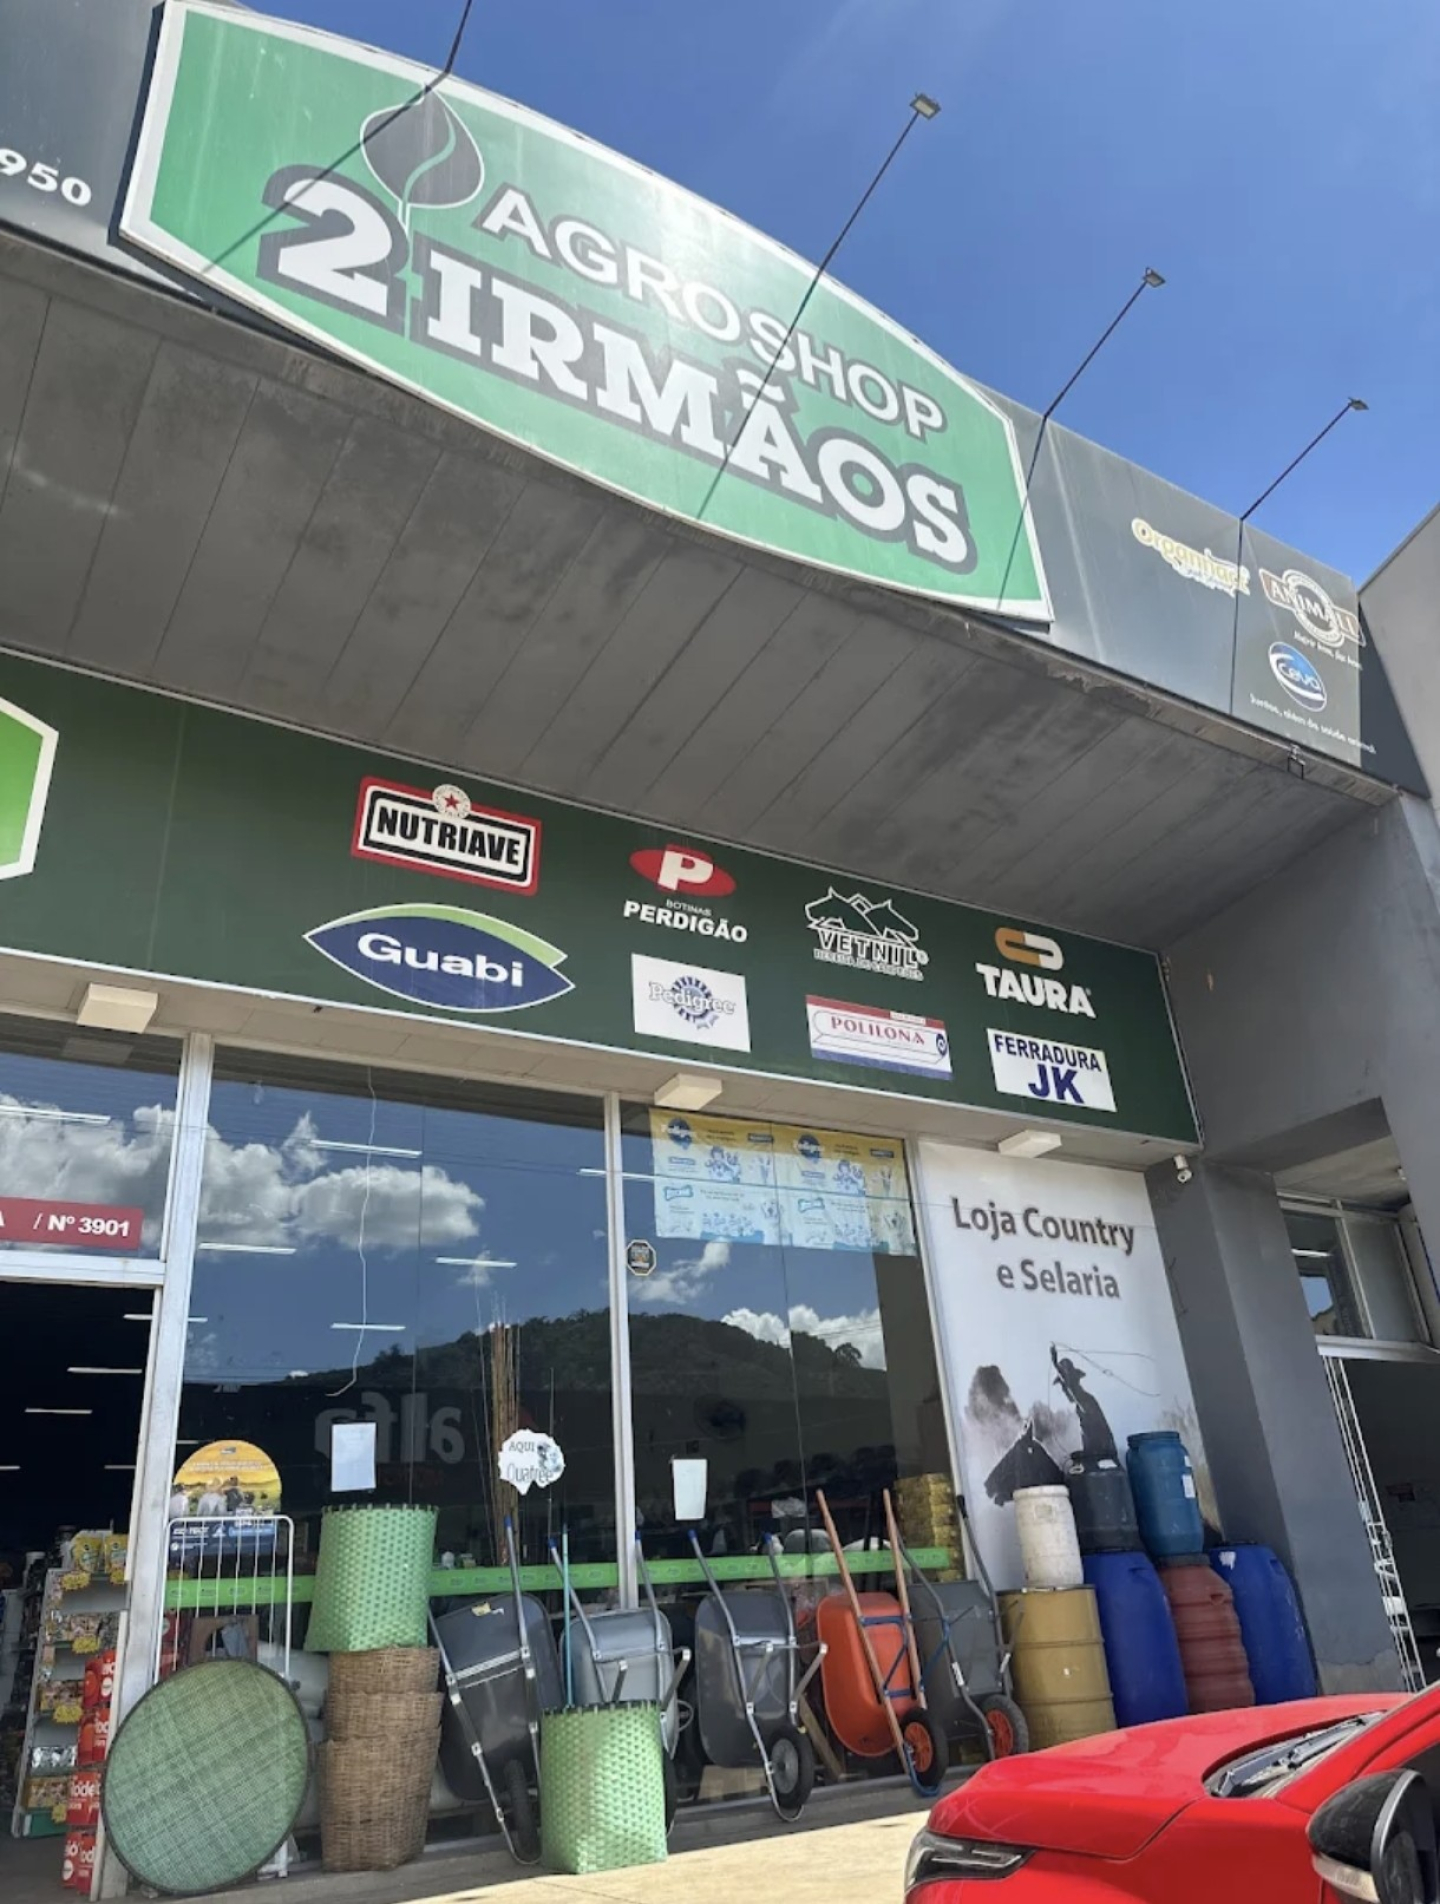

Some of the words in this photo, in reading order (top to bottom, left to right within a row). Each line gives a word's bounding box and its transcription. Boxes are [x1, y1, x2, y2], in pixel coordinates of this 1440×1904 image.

[0, 148, 92, 207] 950
[481, 189, 945, 438] AGROSHOP
[277, 175, 394, 318] 2
[427, 249, 969, 565] IRMÃOS
[376, 805, 521, 867] NUTRIAVE
[656, 850, 714, 891] P
[623, 900, 748, 943] PERDIGÃO
[357, 933, 524, 988] Guabi
[816, 928, 919, 970] VETNIL
[648, 981, 737, 1016] Pedigree
[974, 962, 1097, 1019] TAURA
[831, 1015, 926, 1045] POLILONA
[993, 1034, 1102, 1073] FERRADURA
[1027, 1064, 1085, 1104] JK
[78, 1216, 130, 1237] 3901
[952, 1197, 1017, 1241] Loja
[1024, 1208, 1136, 1255] Country
[997, 1262, 1015, 1289] e
[1020, 1258, 1121, 1300] Selaria
[508, 1440, 535, 1453] AQUI
